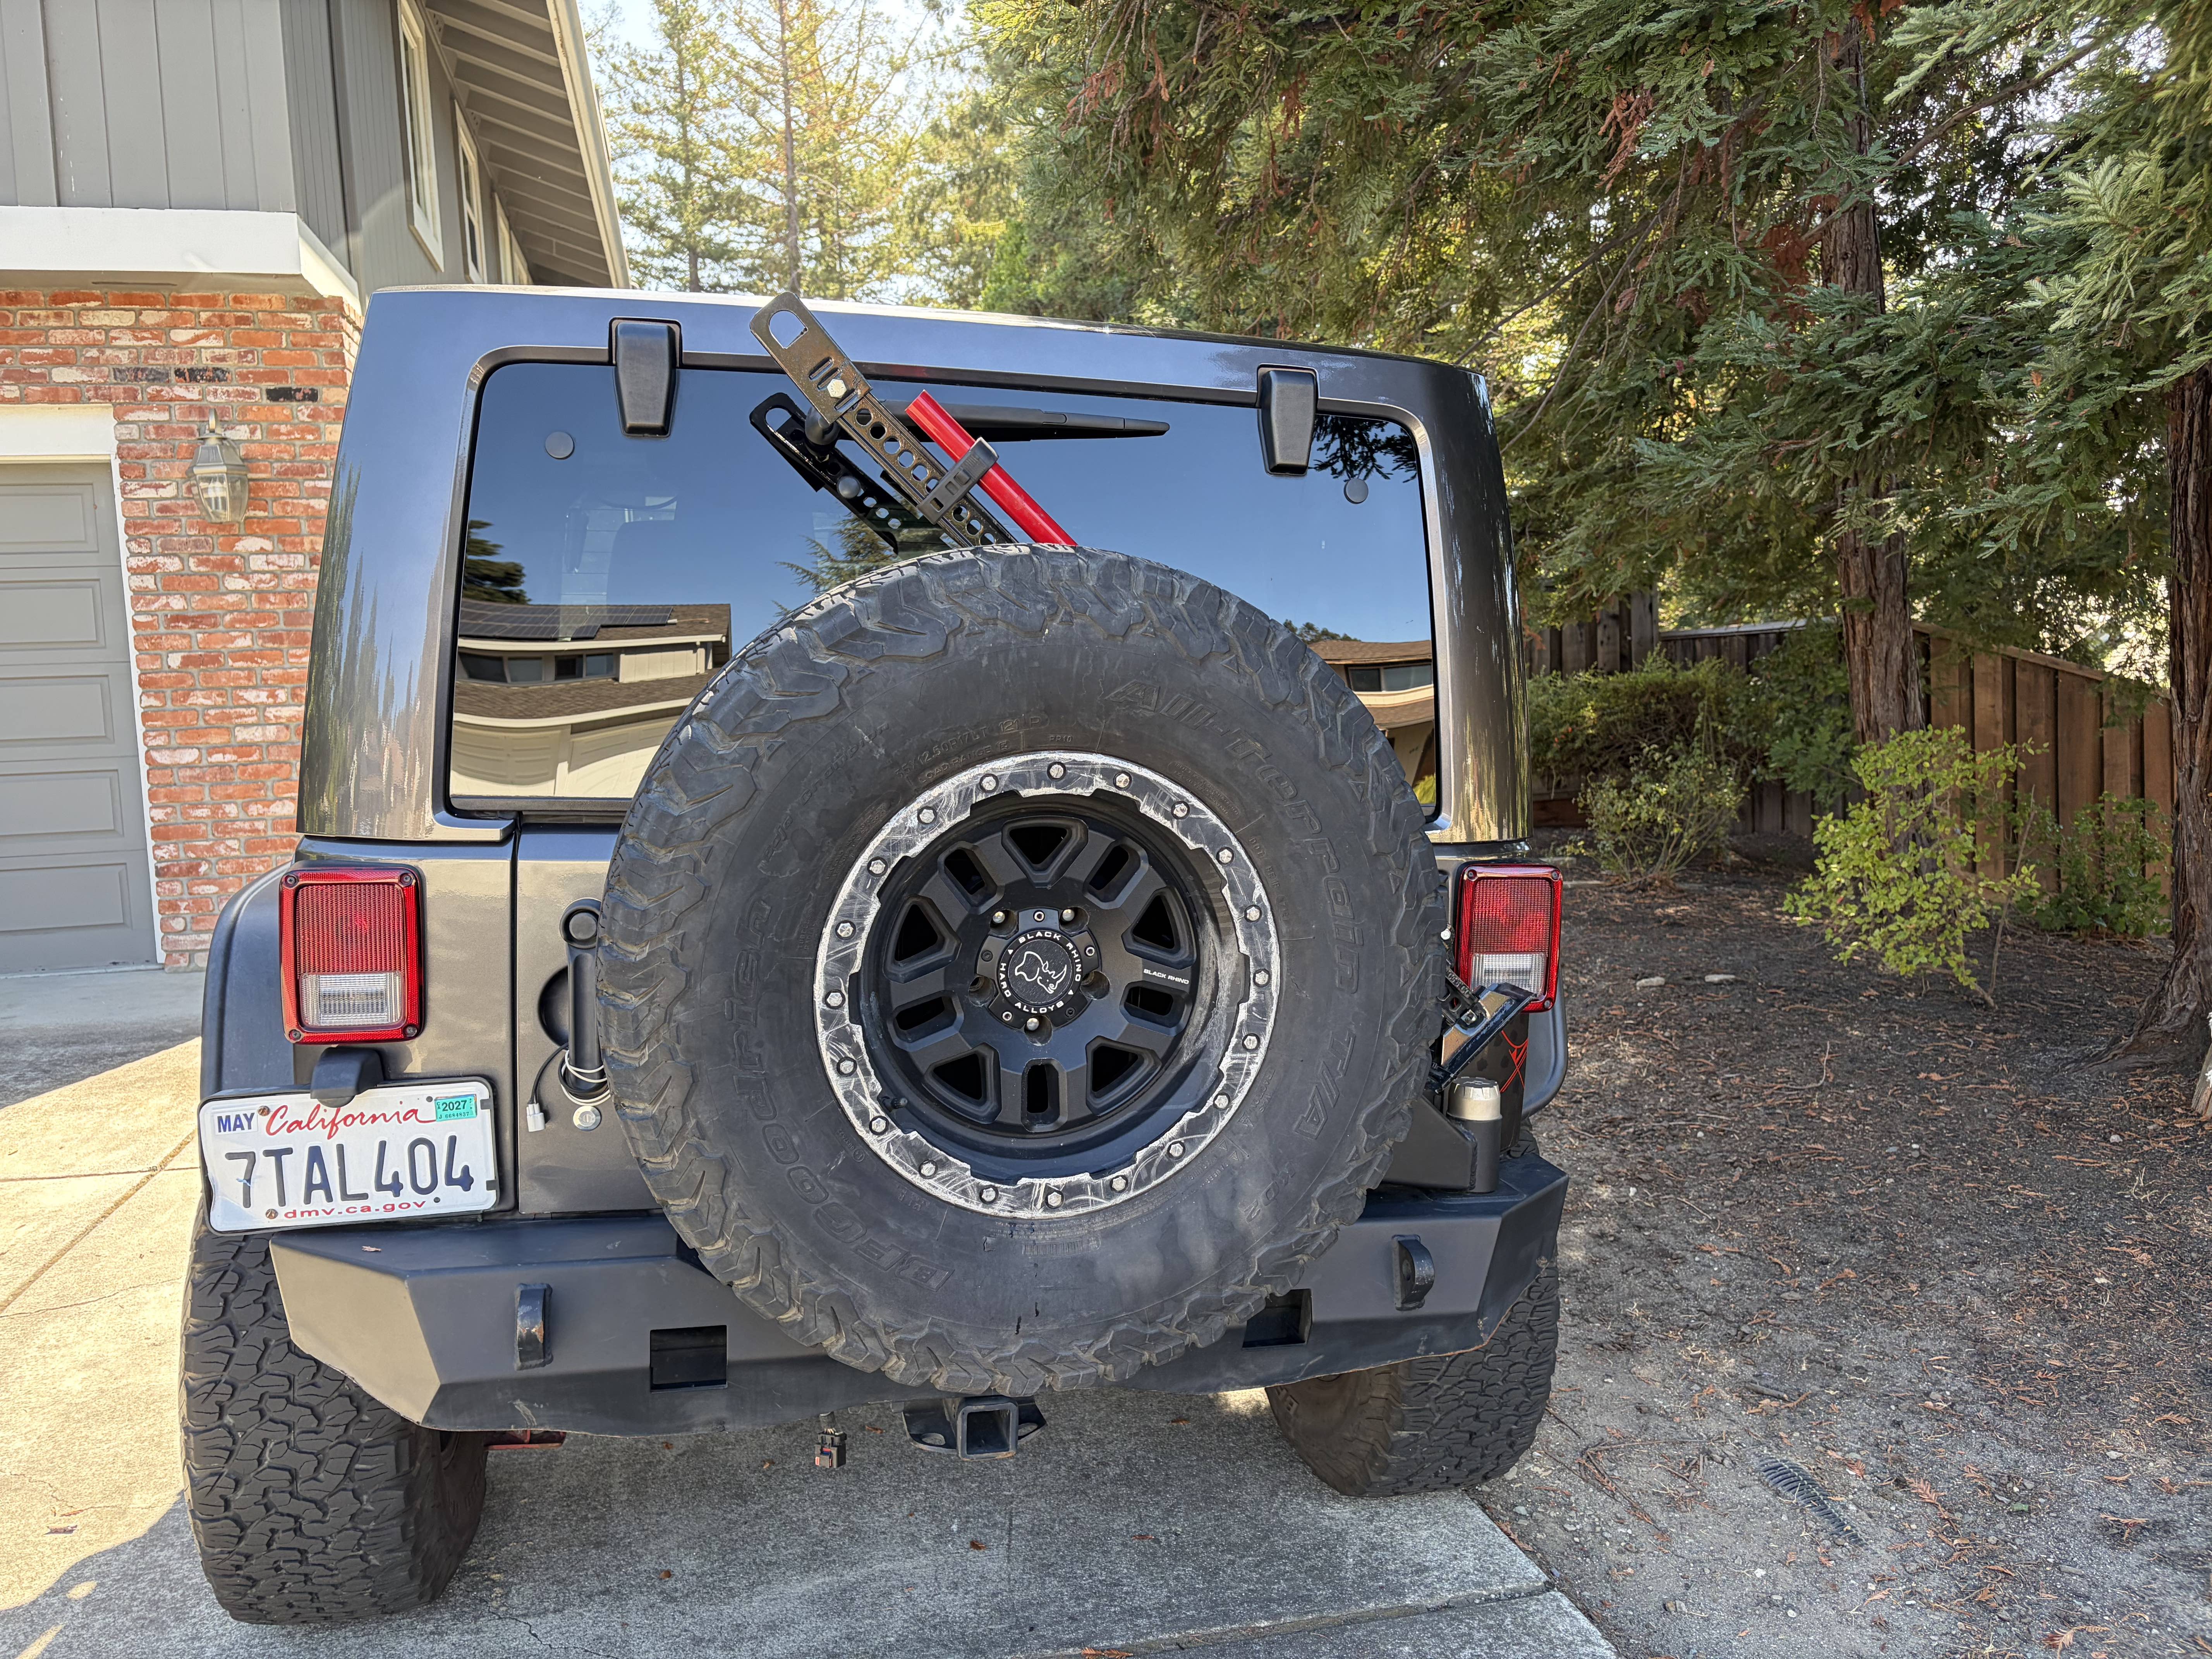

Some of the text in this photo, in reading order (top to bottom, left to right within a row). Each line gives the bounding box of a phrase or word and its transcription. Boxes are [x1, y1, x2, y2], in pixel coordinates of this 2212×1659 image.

[919, 762, 949, 783] LOAD
[1018, 931, 1082, 982] BLACK RHINO
[1143, 968, 1190, 985] BLACK RHINO
[999, 962, 1065, 1014] HARD ALLOYS
[441, 1099, 467, 1112] 2027
[217, 1112, 255, 1133] MAY
[265, 1100, 436, 1140] California
[225, 1135, 474, 1208] 7TAL404
[284, 1200, 426, 1219] dmv.ca.gov
